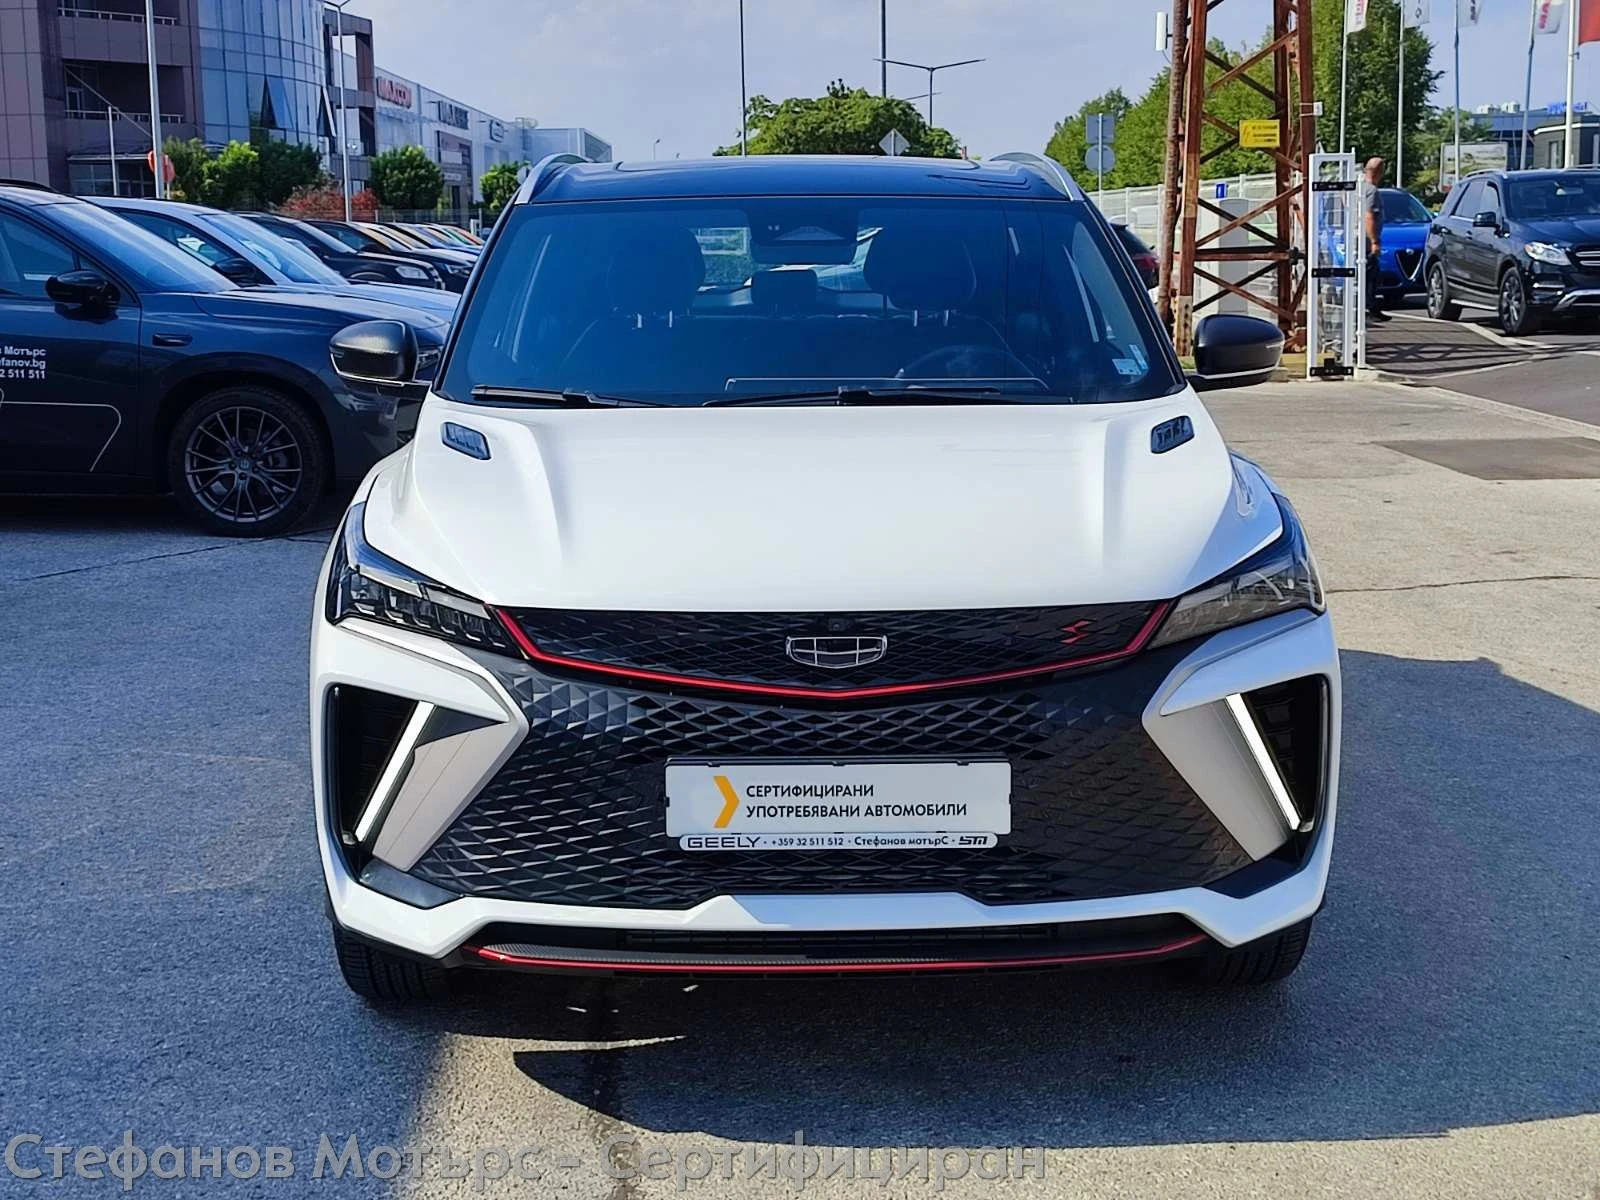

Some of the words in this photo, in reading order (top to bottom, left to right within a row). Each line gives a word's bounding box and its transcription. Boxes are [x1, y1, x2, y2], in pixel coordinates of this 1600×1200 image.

[4, 345, 46, 358] Мотърс
[0, 357, 46, 370] fanov.bg
[8, 369, 25, 378] 511
[28, 369, 46, 379] 511
[746, 784, 874, 799] СЕРТИФИЦИРАНИ
[746, 804, 860, 818] УПОТРЕБЯВАНИ
[864, 803, 967, 817] АВТОМОБИЛИ
[687, 836, 761, 849] GEELY
[772, 837, 793, 847] +359
[796, 837, 808, 846] 32
[809, 837, 825, 846] 511
[827, 837, 844, 846] 512
[854, 836, 906, 848] Стефанов
